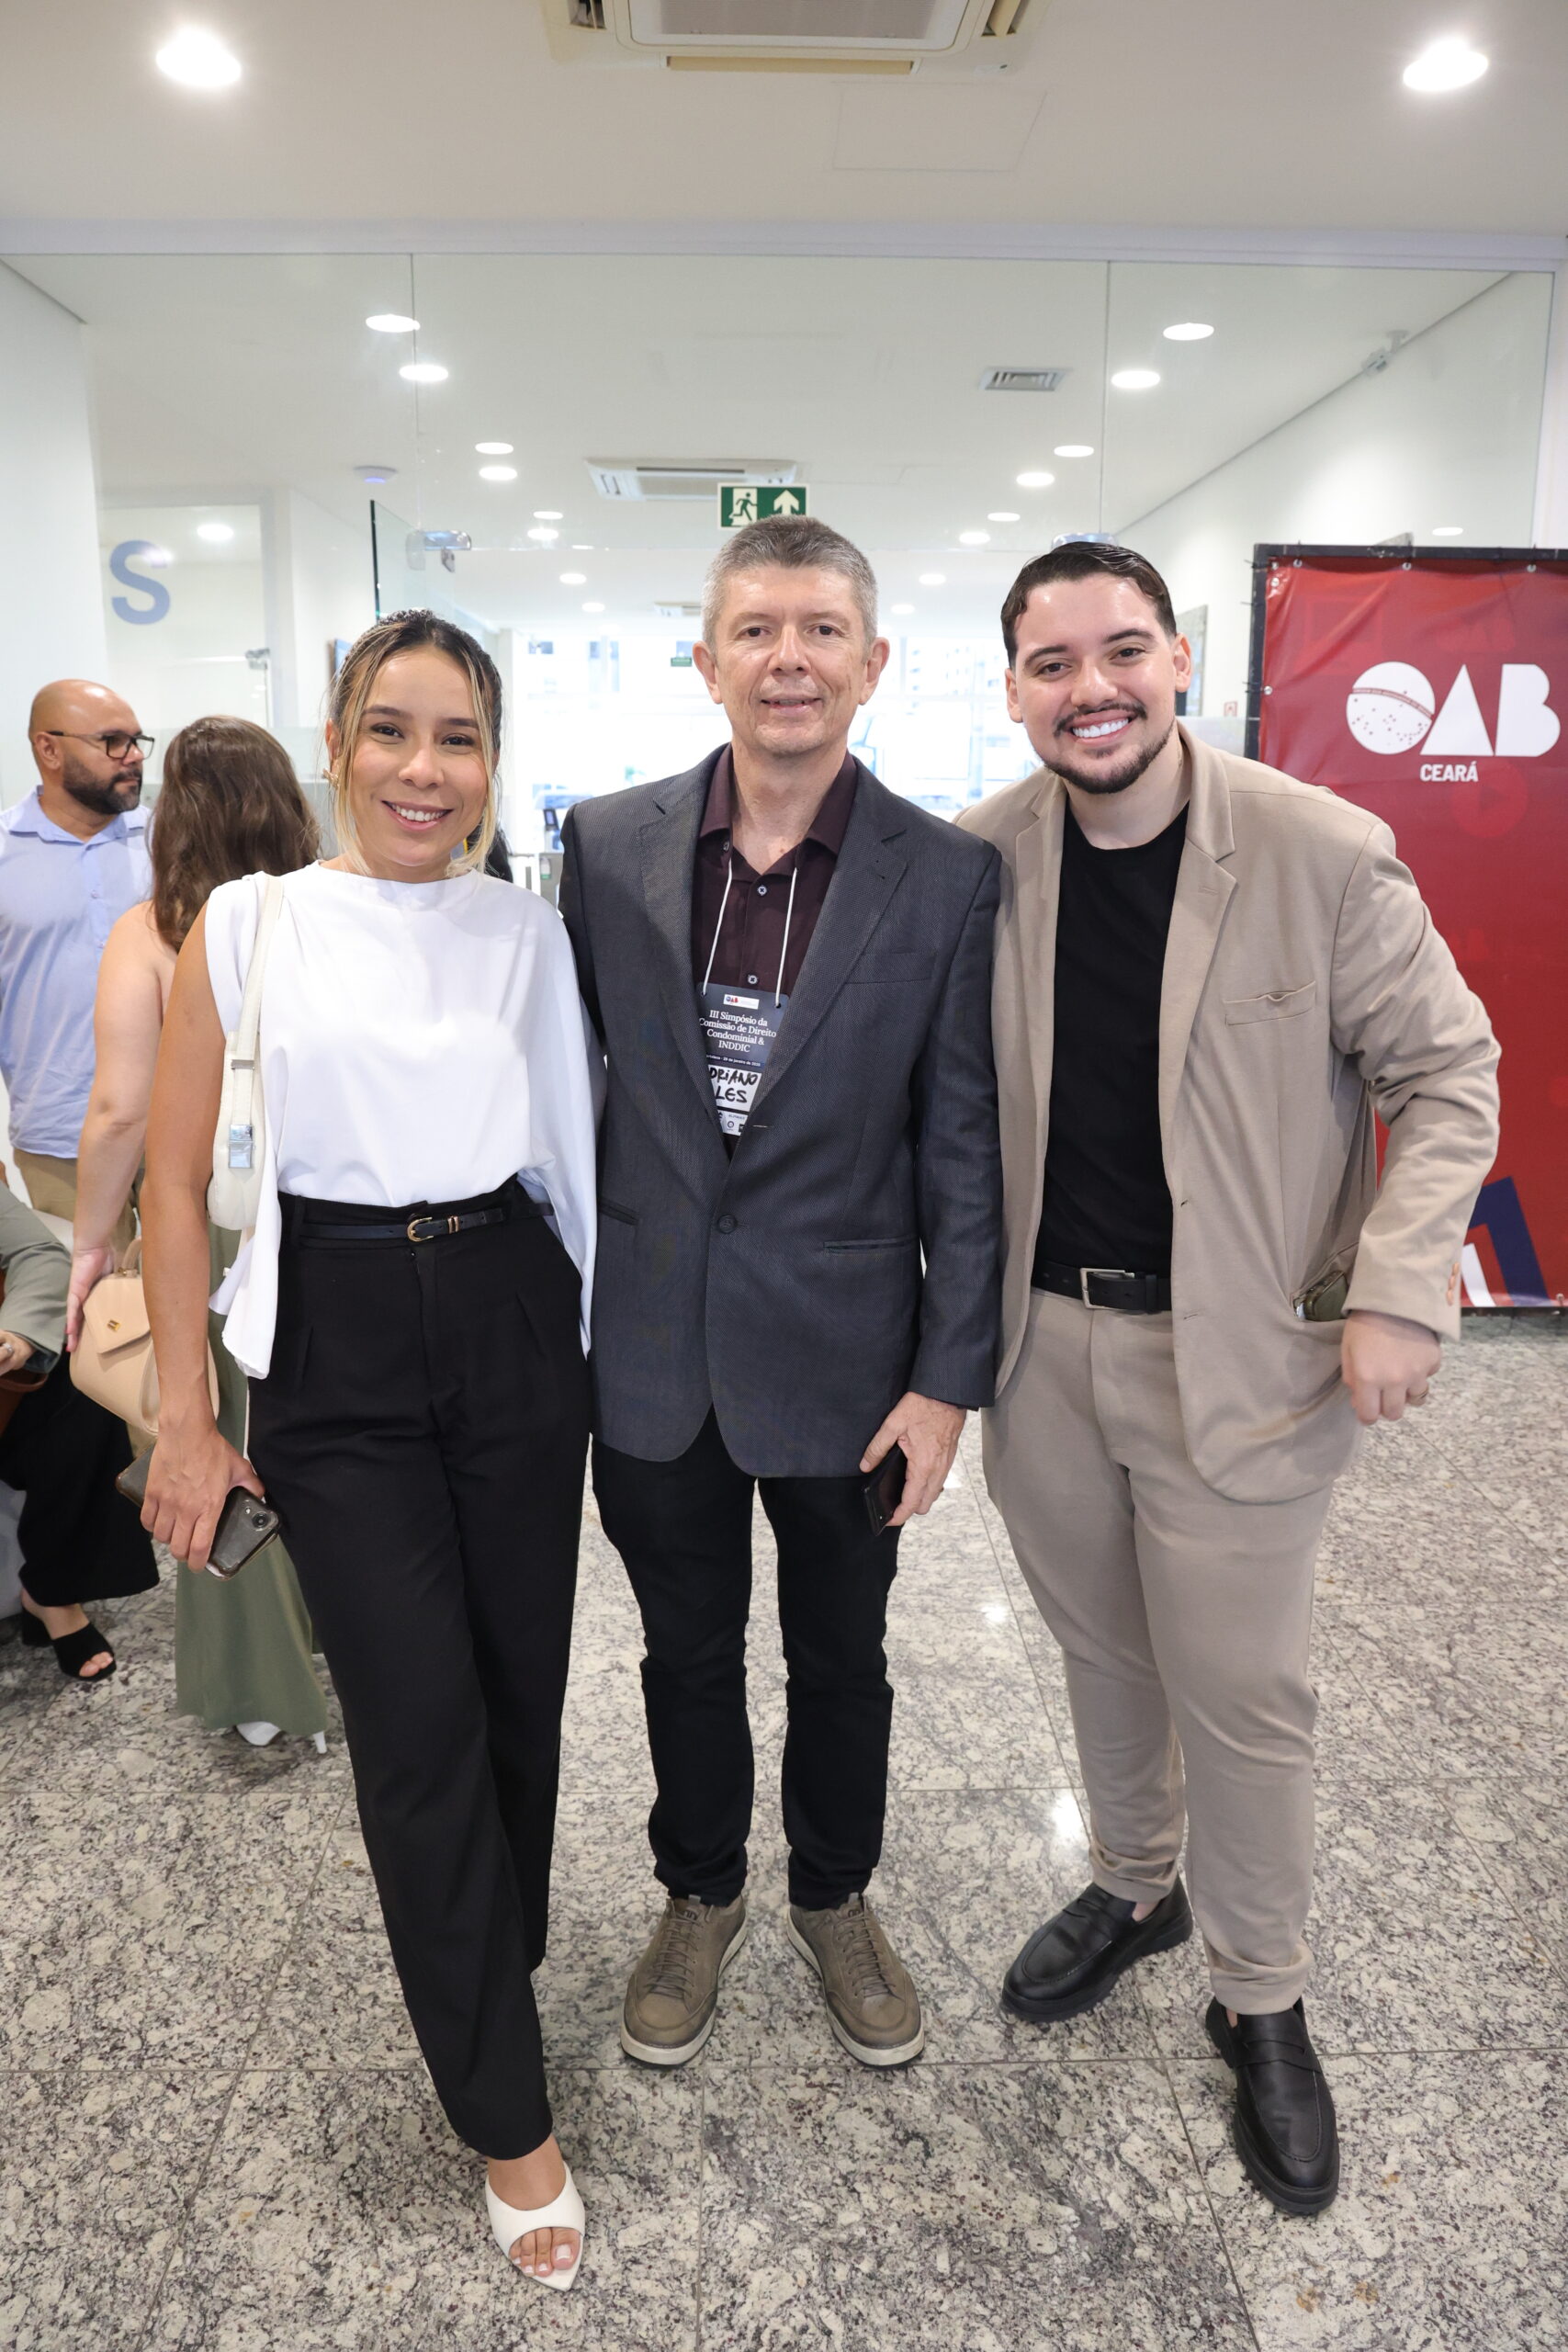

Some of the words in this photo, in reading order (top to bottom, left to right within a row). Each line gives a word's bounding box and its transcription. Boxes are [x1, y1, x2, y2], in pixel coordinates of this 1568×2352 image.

[109, 539, 172, 626] S
[1346, 661, 1561, 758] OAB
[1420, 761, 1479, 783] CEARÁ
[699, 1017, 736, 1031] Comissão
[737, 1024, 748, 1033] de
[749, 1025, 777, 1038] Direito
[709, 1010, 720, 1019] III
[720, 1012, 757, 1025] Simpósio
[758, 1017, 768, 1027] da
[706, 1029, 758, 1044] Condominial
[758, 1037, 765, 1046] &
[718, 1040, 750, 1052] INDDIC
